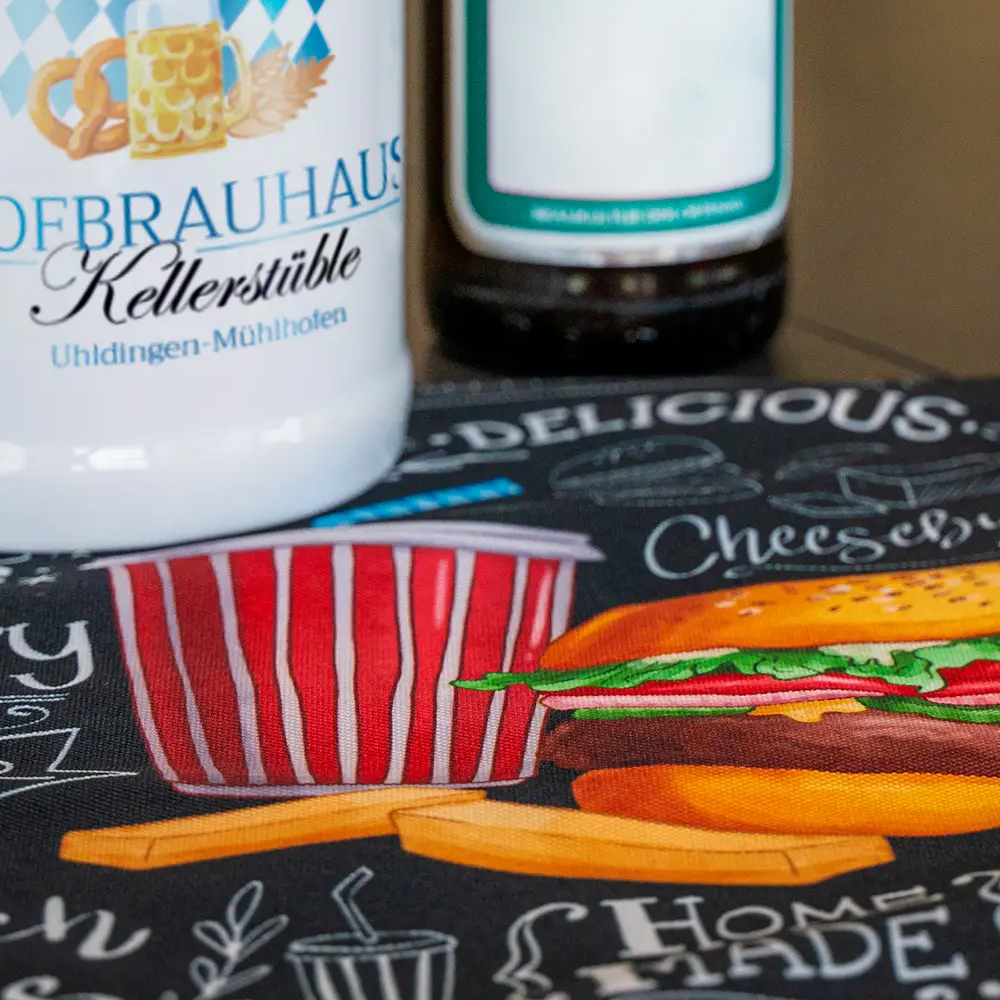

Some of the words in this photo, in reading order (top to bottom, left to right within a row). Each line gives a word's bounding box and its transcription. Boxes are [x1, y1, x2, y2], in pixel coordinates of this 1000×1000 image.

[29, 227, 361, 326] Kellerstüble
[50, 305, 348, 368] Uhldingen-Mühlhofen
[453, 387, 969, 450] DELICIOUS
